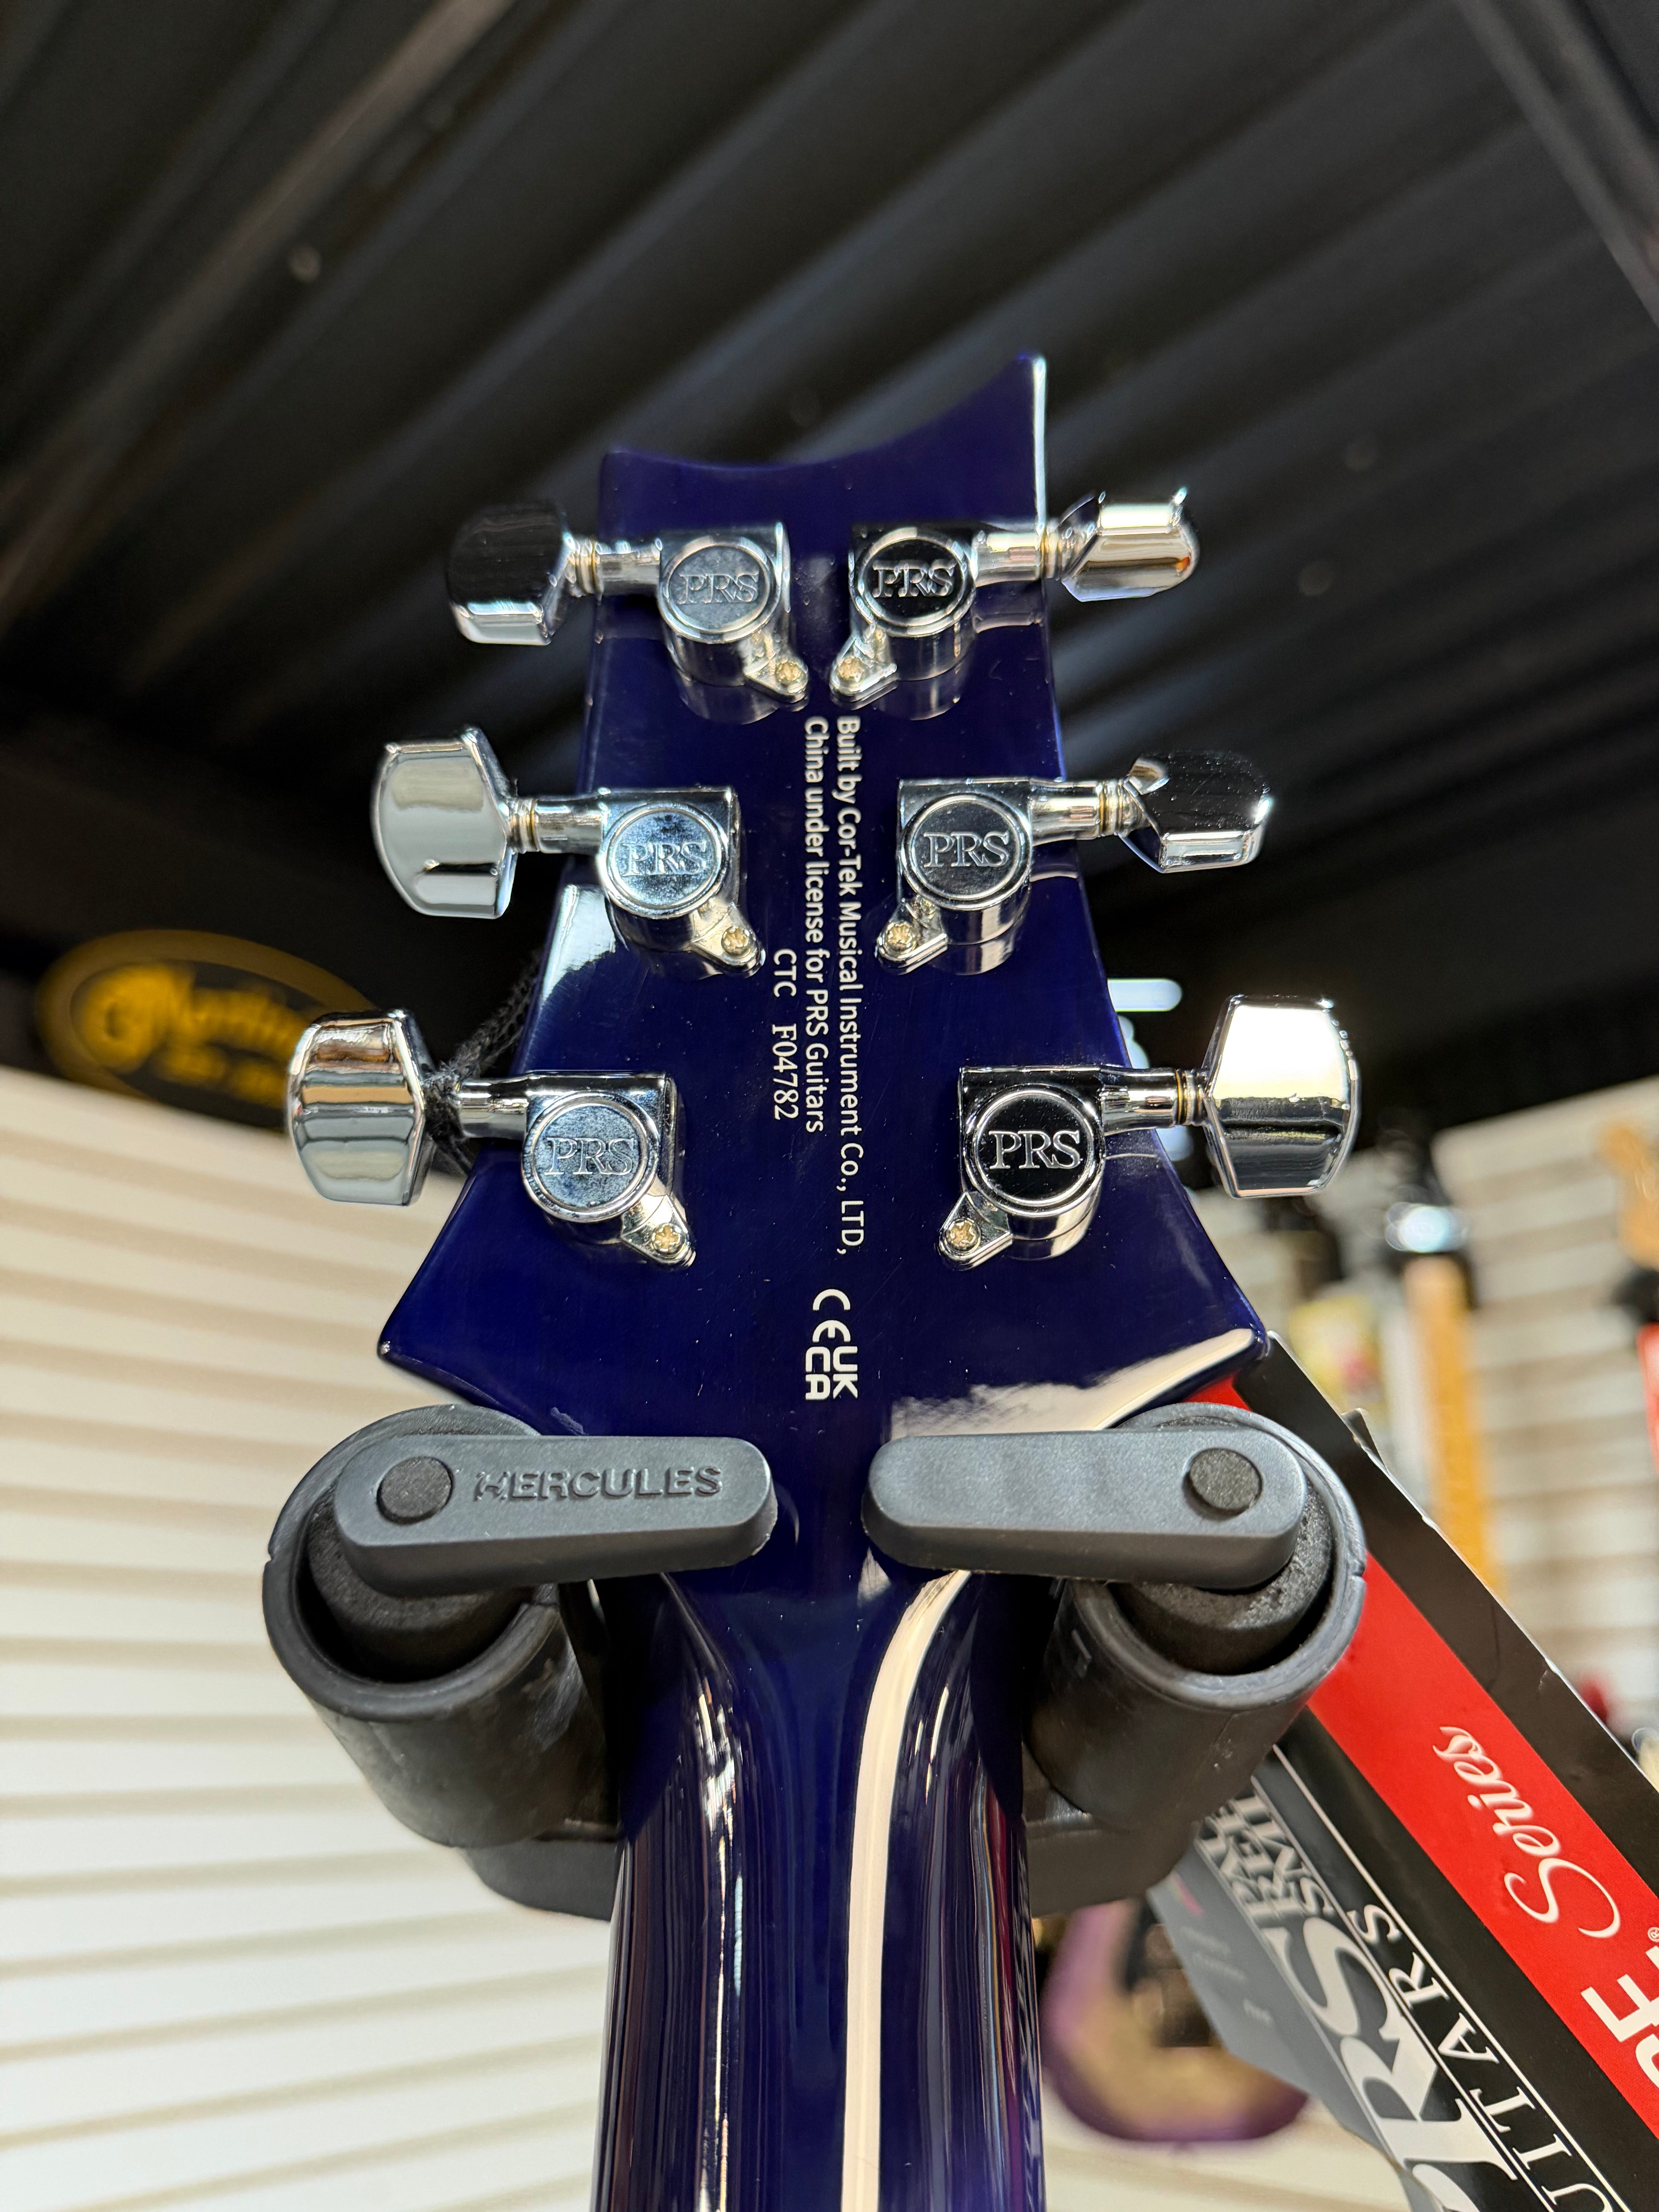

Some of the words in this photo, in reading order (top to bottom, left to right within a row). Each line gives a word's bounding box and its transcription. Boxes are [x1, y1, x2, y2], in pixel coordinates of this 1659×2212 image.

[678, 571, 759, 605] PRS
[872, 559, 957, 598] PRS
[805, 718, 830, 783] China
[837, 717, 862, 771] Built
[832, 775, 862, 804] by
[805, 788, 830, 857] under
[923, 830, 1010, 868] PRS
[622, 840, 707, 876] PRS
[838, 808, 862, 896] Cor-Tek
[806, 862, 830, 943] license
[774, 949, 797, 997] CTC
[806, 948, 830, 983] for
[839, 902, 864, 990] Musical
[806, 990, 828, 1036] PRS
[772, 1023, 799, 1120] F04782
[806, 1043, 829, 1132] Guitars
[840, 998, 862, 1135] Instrument
[544, 1136, 636, 1176] PRS
[836, 1143, 864, 1191] Co.,
[988, 1130, 1083, 1169] PRS
[812, 1289, 851, 1343] CE
[474, 1465, 723, 1502] HERCULES
[1432, 1726, 1621, 1938] Series
[1259, 1917, 1517, 2212] RS
[1346, 1904, 1612, 2212] UITARS
